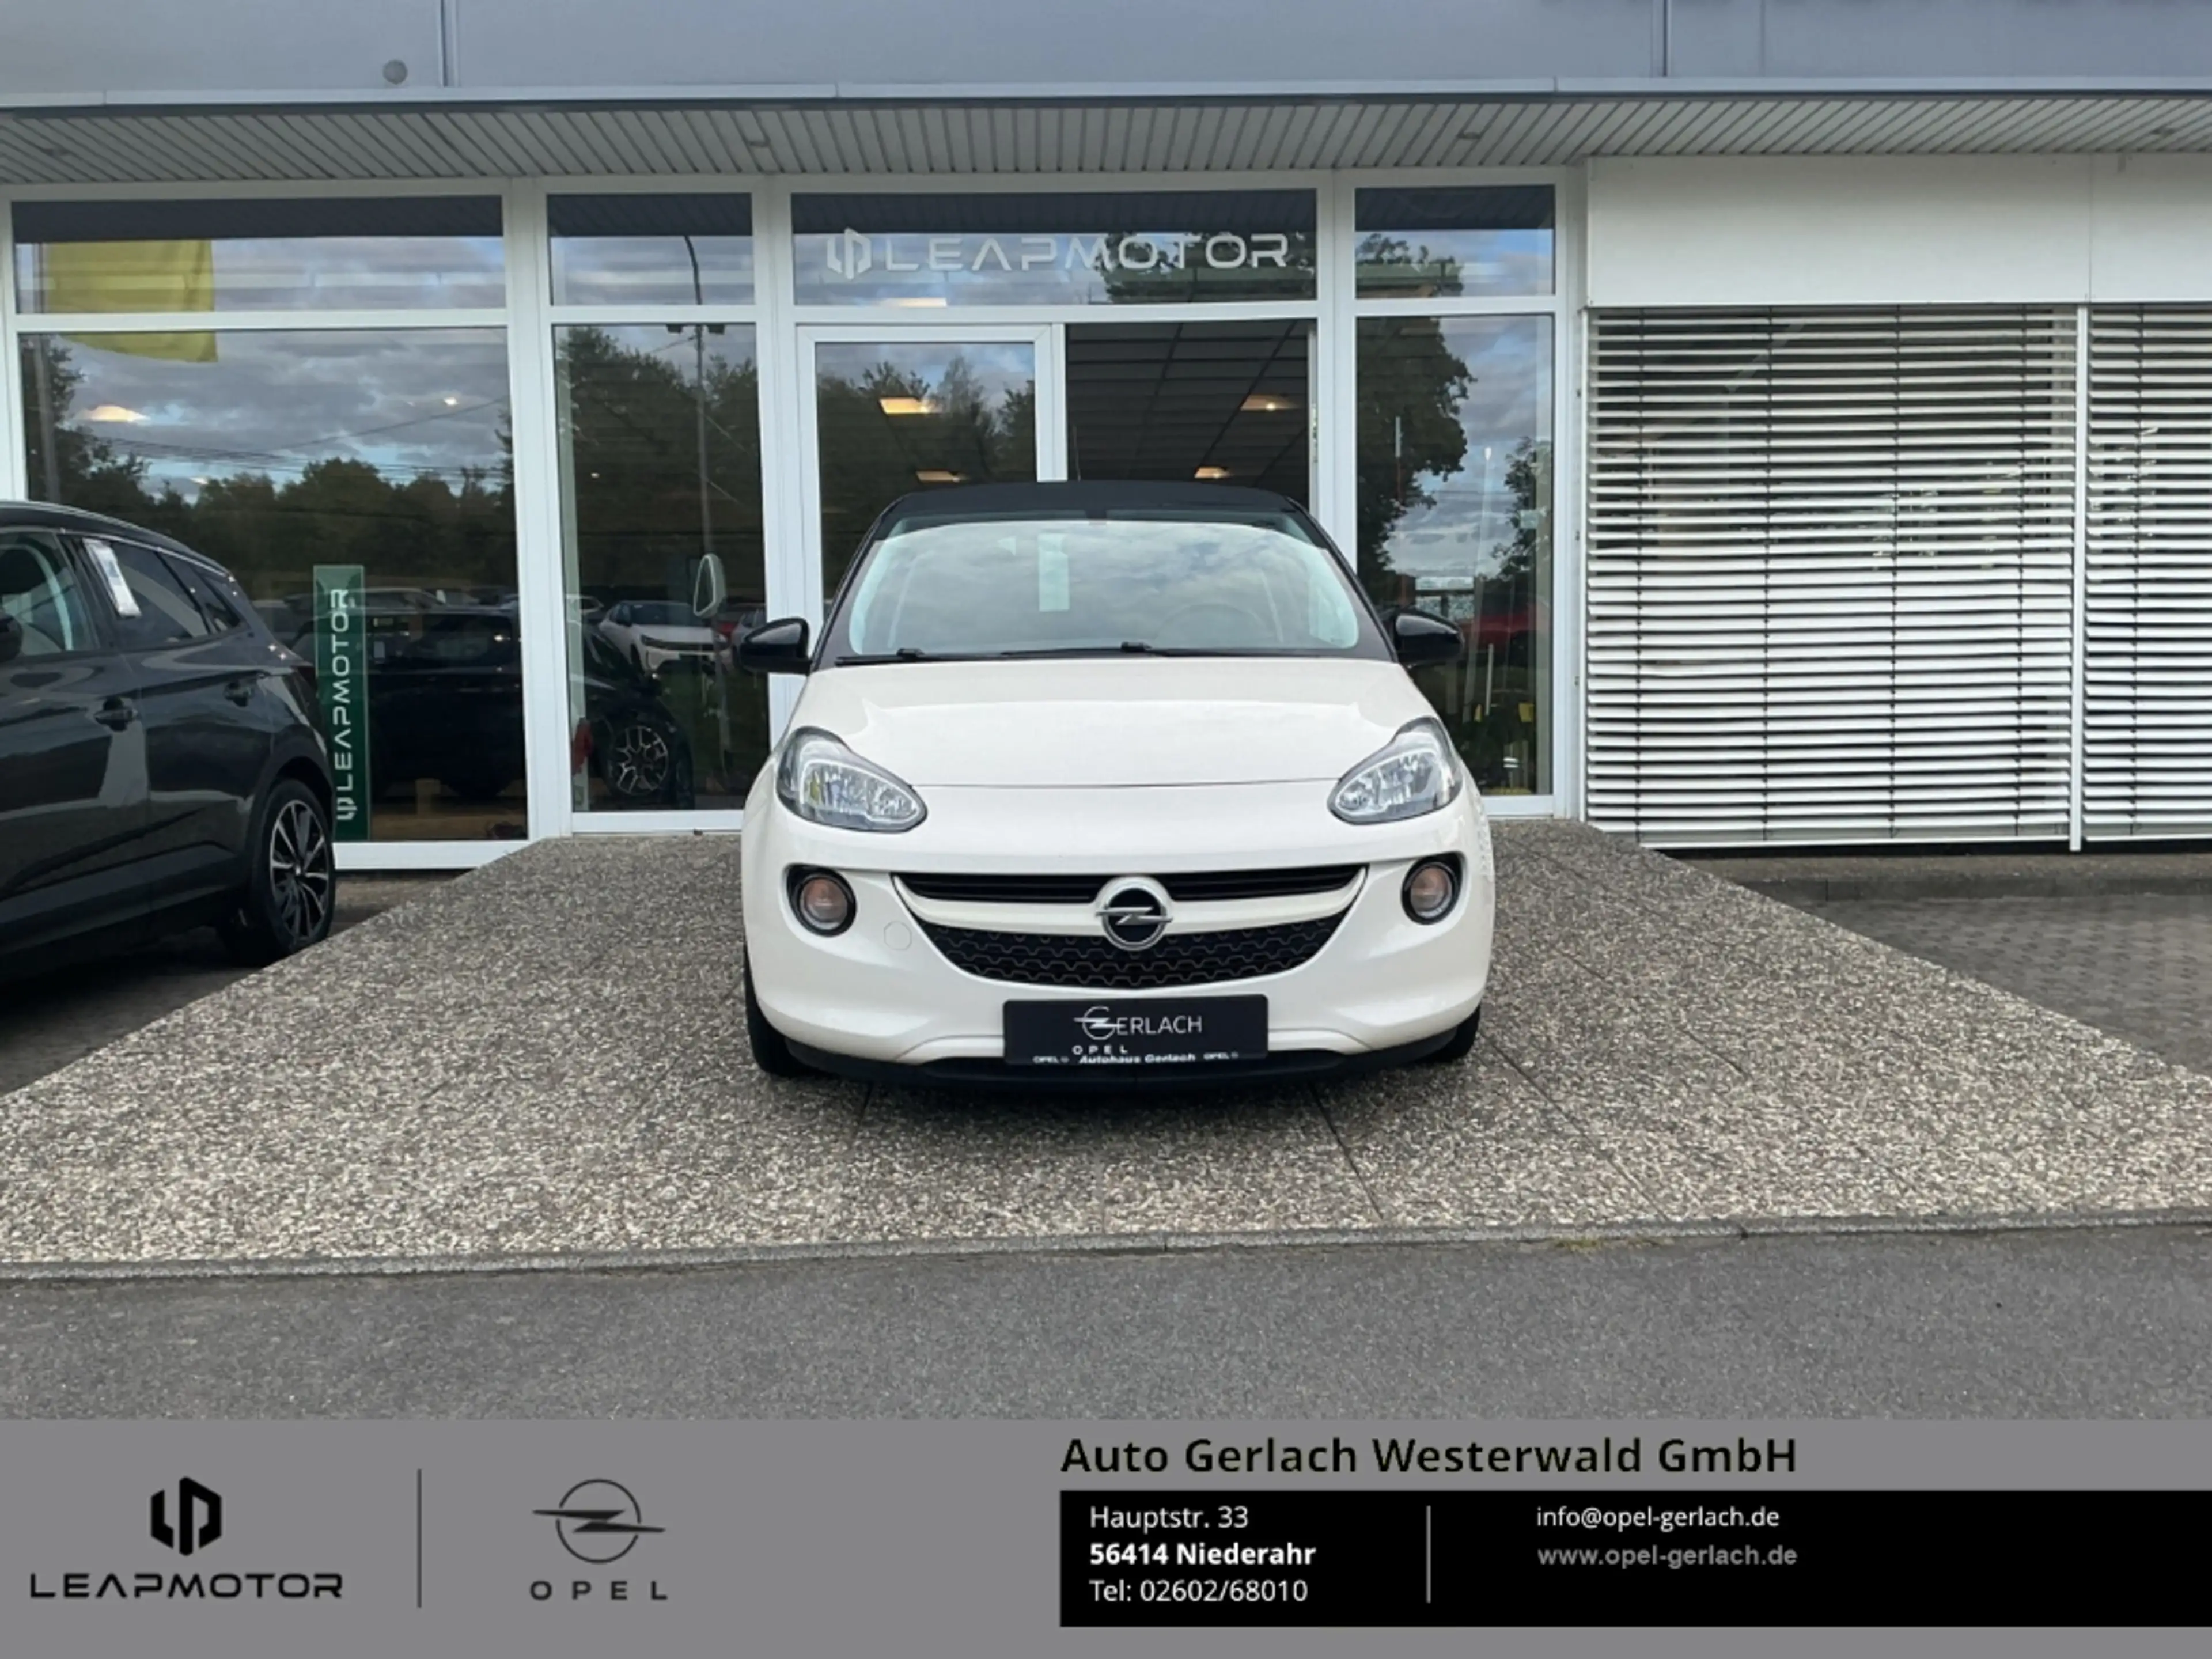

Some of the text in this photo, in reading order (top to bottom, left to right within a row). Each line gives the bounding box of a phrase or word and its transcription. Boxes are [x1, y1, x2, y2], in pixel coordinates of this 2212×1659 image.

[885, 234, 1289, 271] LEAPMOTOR
[331, 588, 354, 793] LEAPMOTOR
[1072, 1044, 1128, 1055] OPEL
[1079, 1052, 1195, 1064] Autohaus Gerlach
